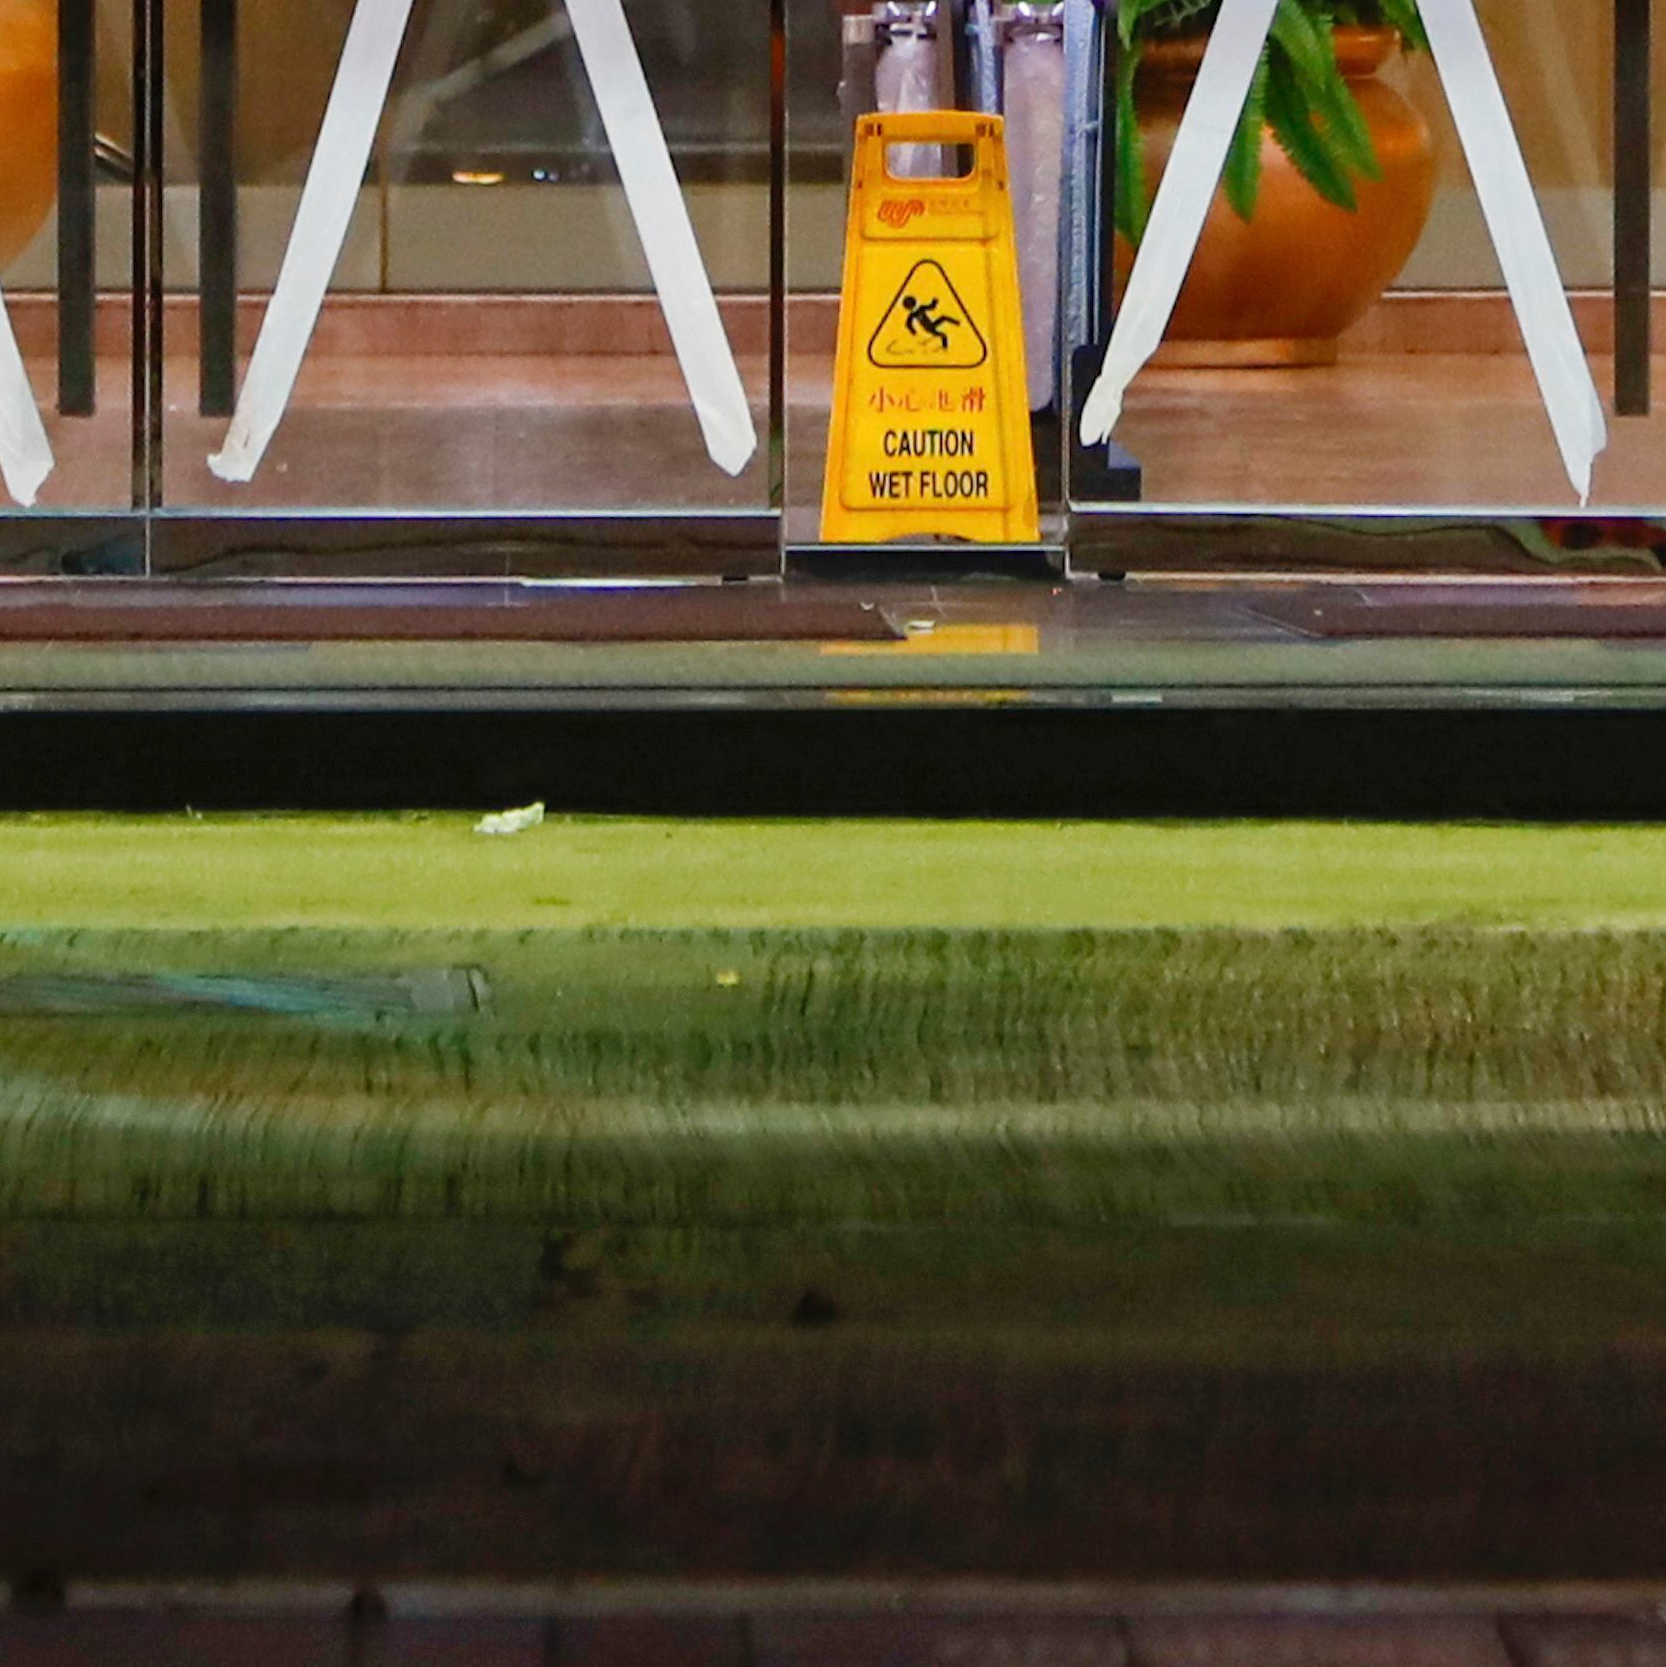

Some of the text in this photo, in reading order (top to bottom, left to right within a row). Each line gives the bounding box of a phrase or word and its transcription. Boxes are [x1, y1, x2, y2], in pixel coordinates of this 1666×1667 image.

[883, 429, 974, 456] CAUTION
[869, 470, 989, 499] WET FLOOR
